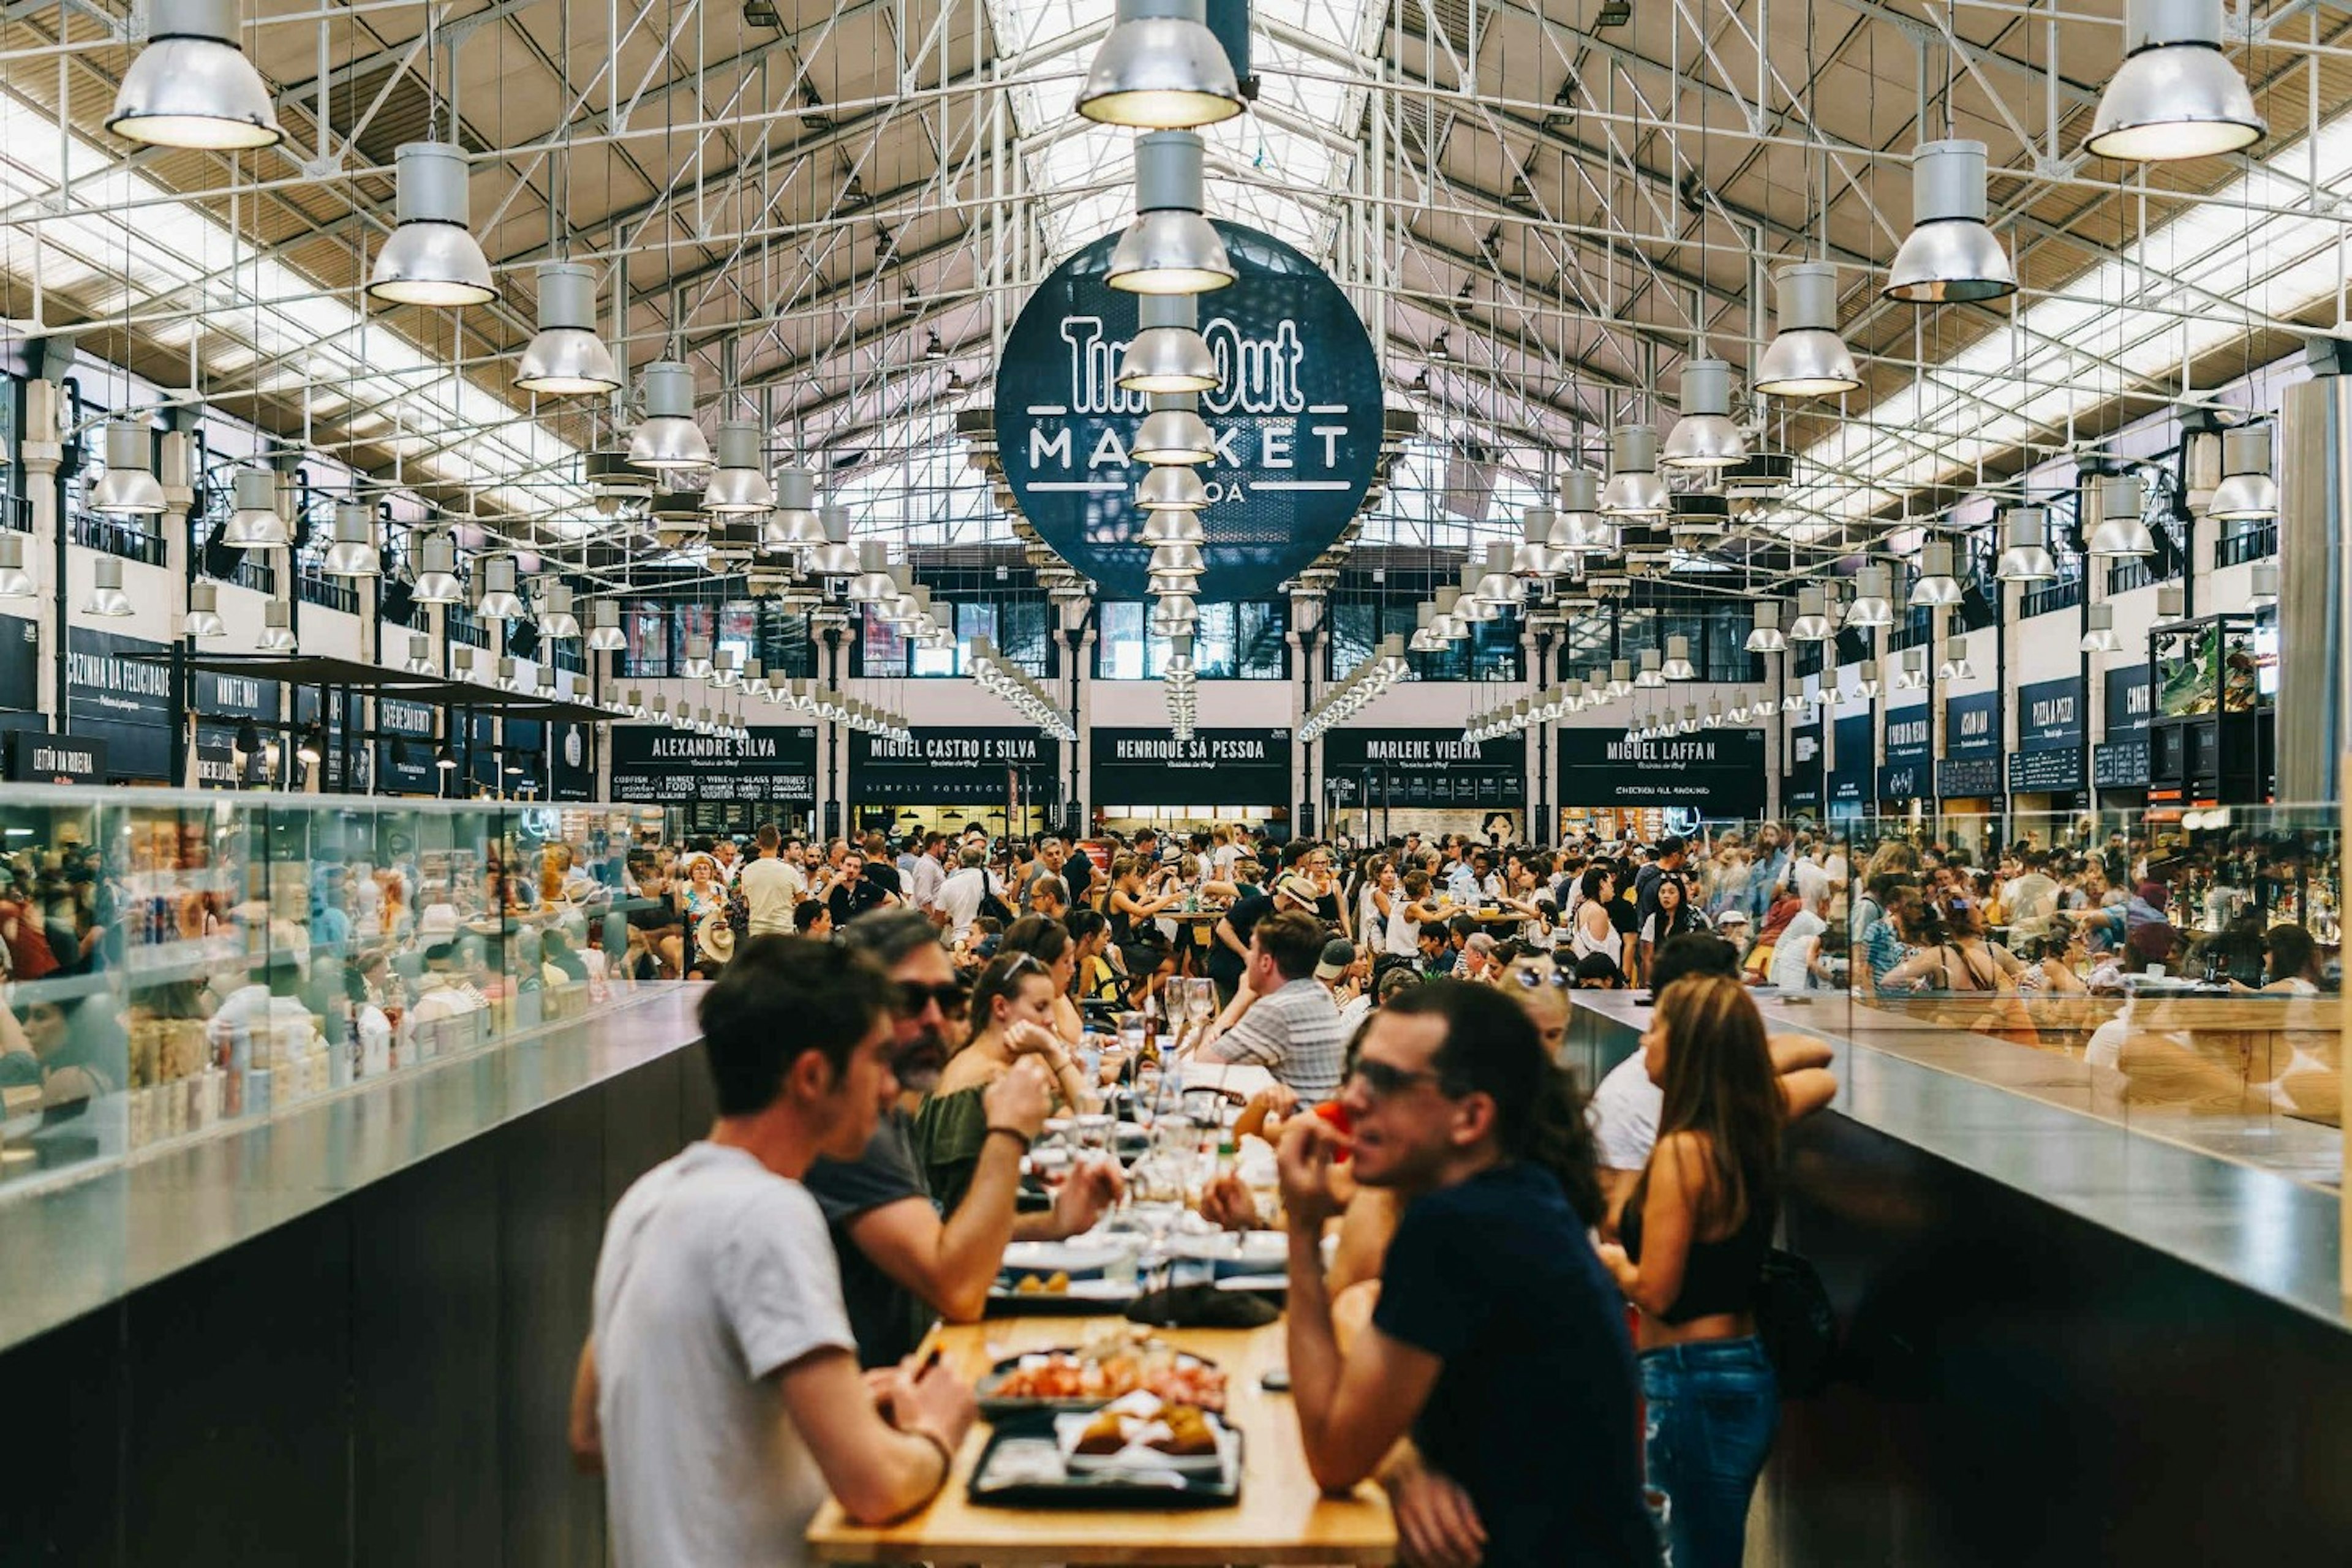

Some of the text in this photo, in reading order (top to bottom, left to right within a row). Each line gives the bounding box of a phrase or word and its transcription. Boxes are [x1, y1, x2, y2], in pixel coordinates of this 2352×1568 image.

[1061, 315, 1304, 413] Tim Out
[1029, 426, 1348, 469] MAKET
[652, 737, 776, 757] ALEXANDRE SILVA
[870, 739, 1036, 758] MIGUEL CASTRO E SILVA
[1117, 736, 1265, 760] HENRIQUE SÁ PESSOA
[1366, 740, 1481, 760] MARLENE VIEIRA
[1606, 742, 1715, 760] MIGUEL LAFFAN
